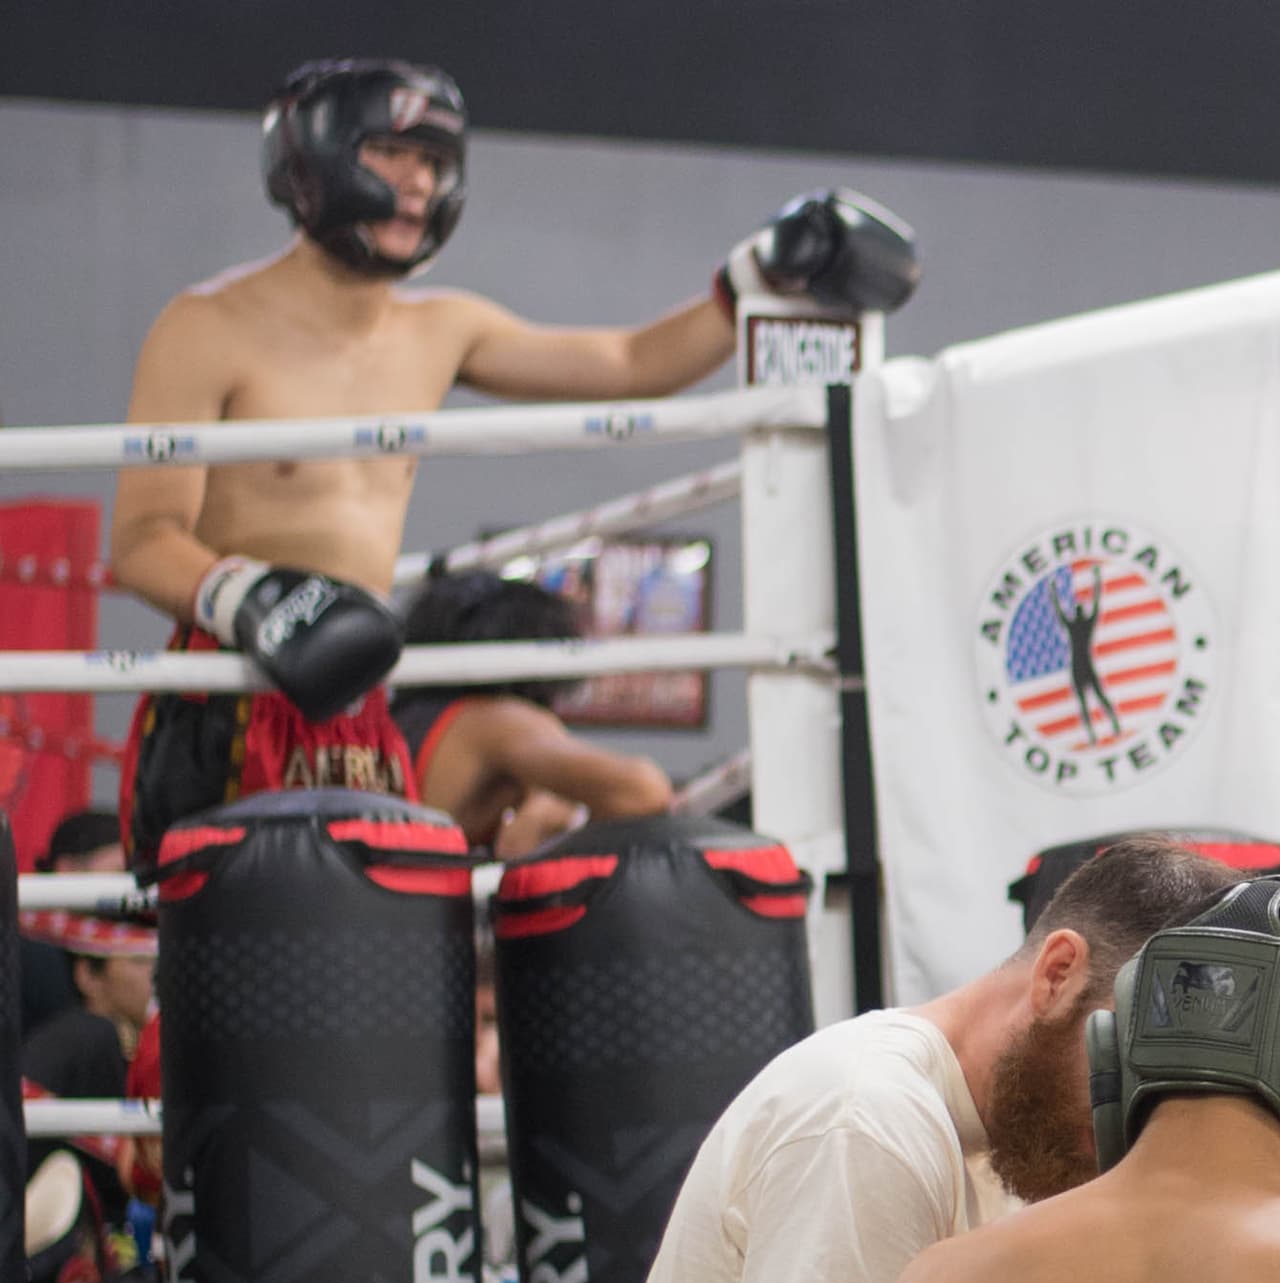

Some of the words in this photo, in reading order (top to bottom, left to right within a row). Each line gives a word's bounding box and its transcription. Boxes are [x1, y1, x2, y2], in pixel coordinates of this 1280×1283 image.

[981, 527, 1193, 646] AMERICAN
[1005, 719, 1078, 784] TOP
[1098, 677, 1206, 782] TEAM
